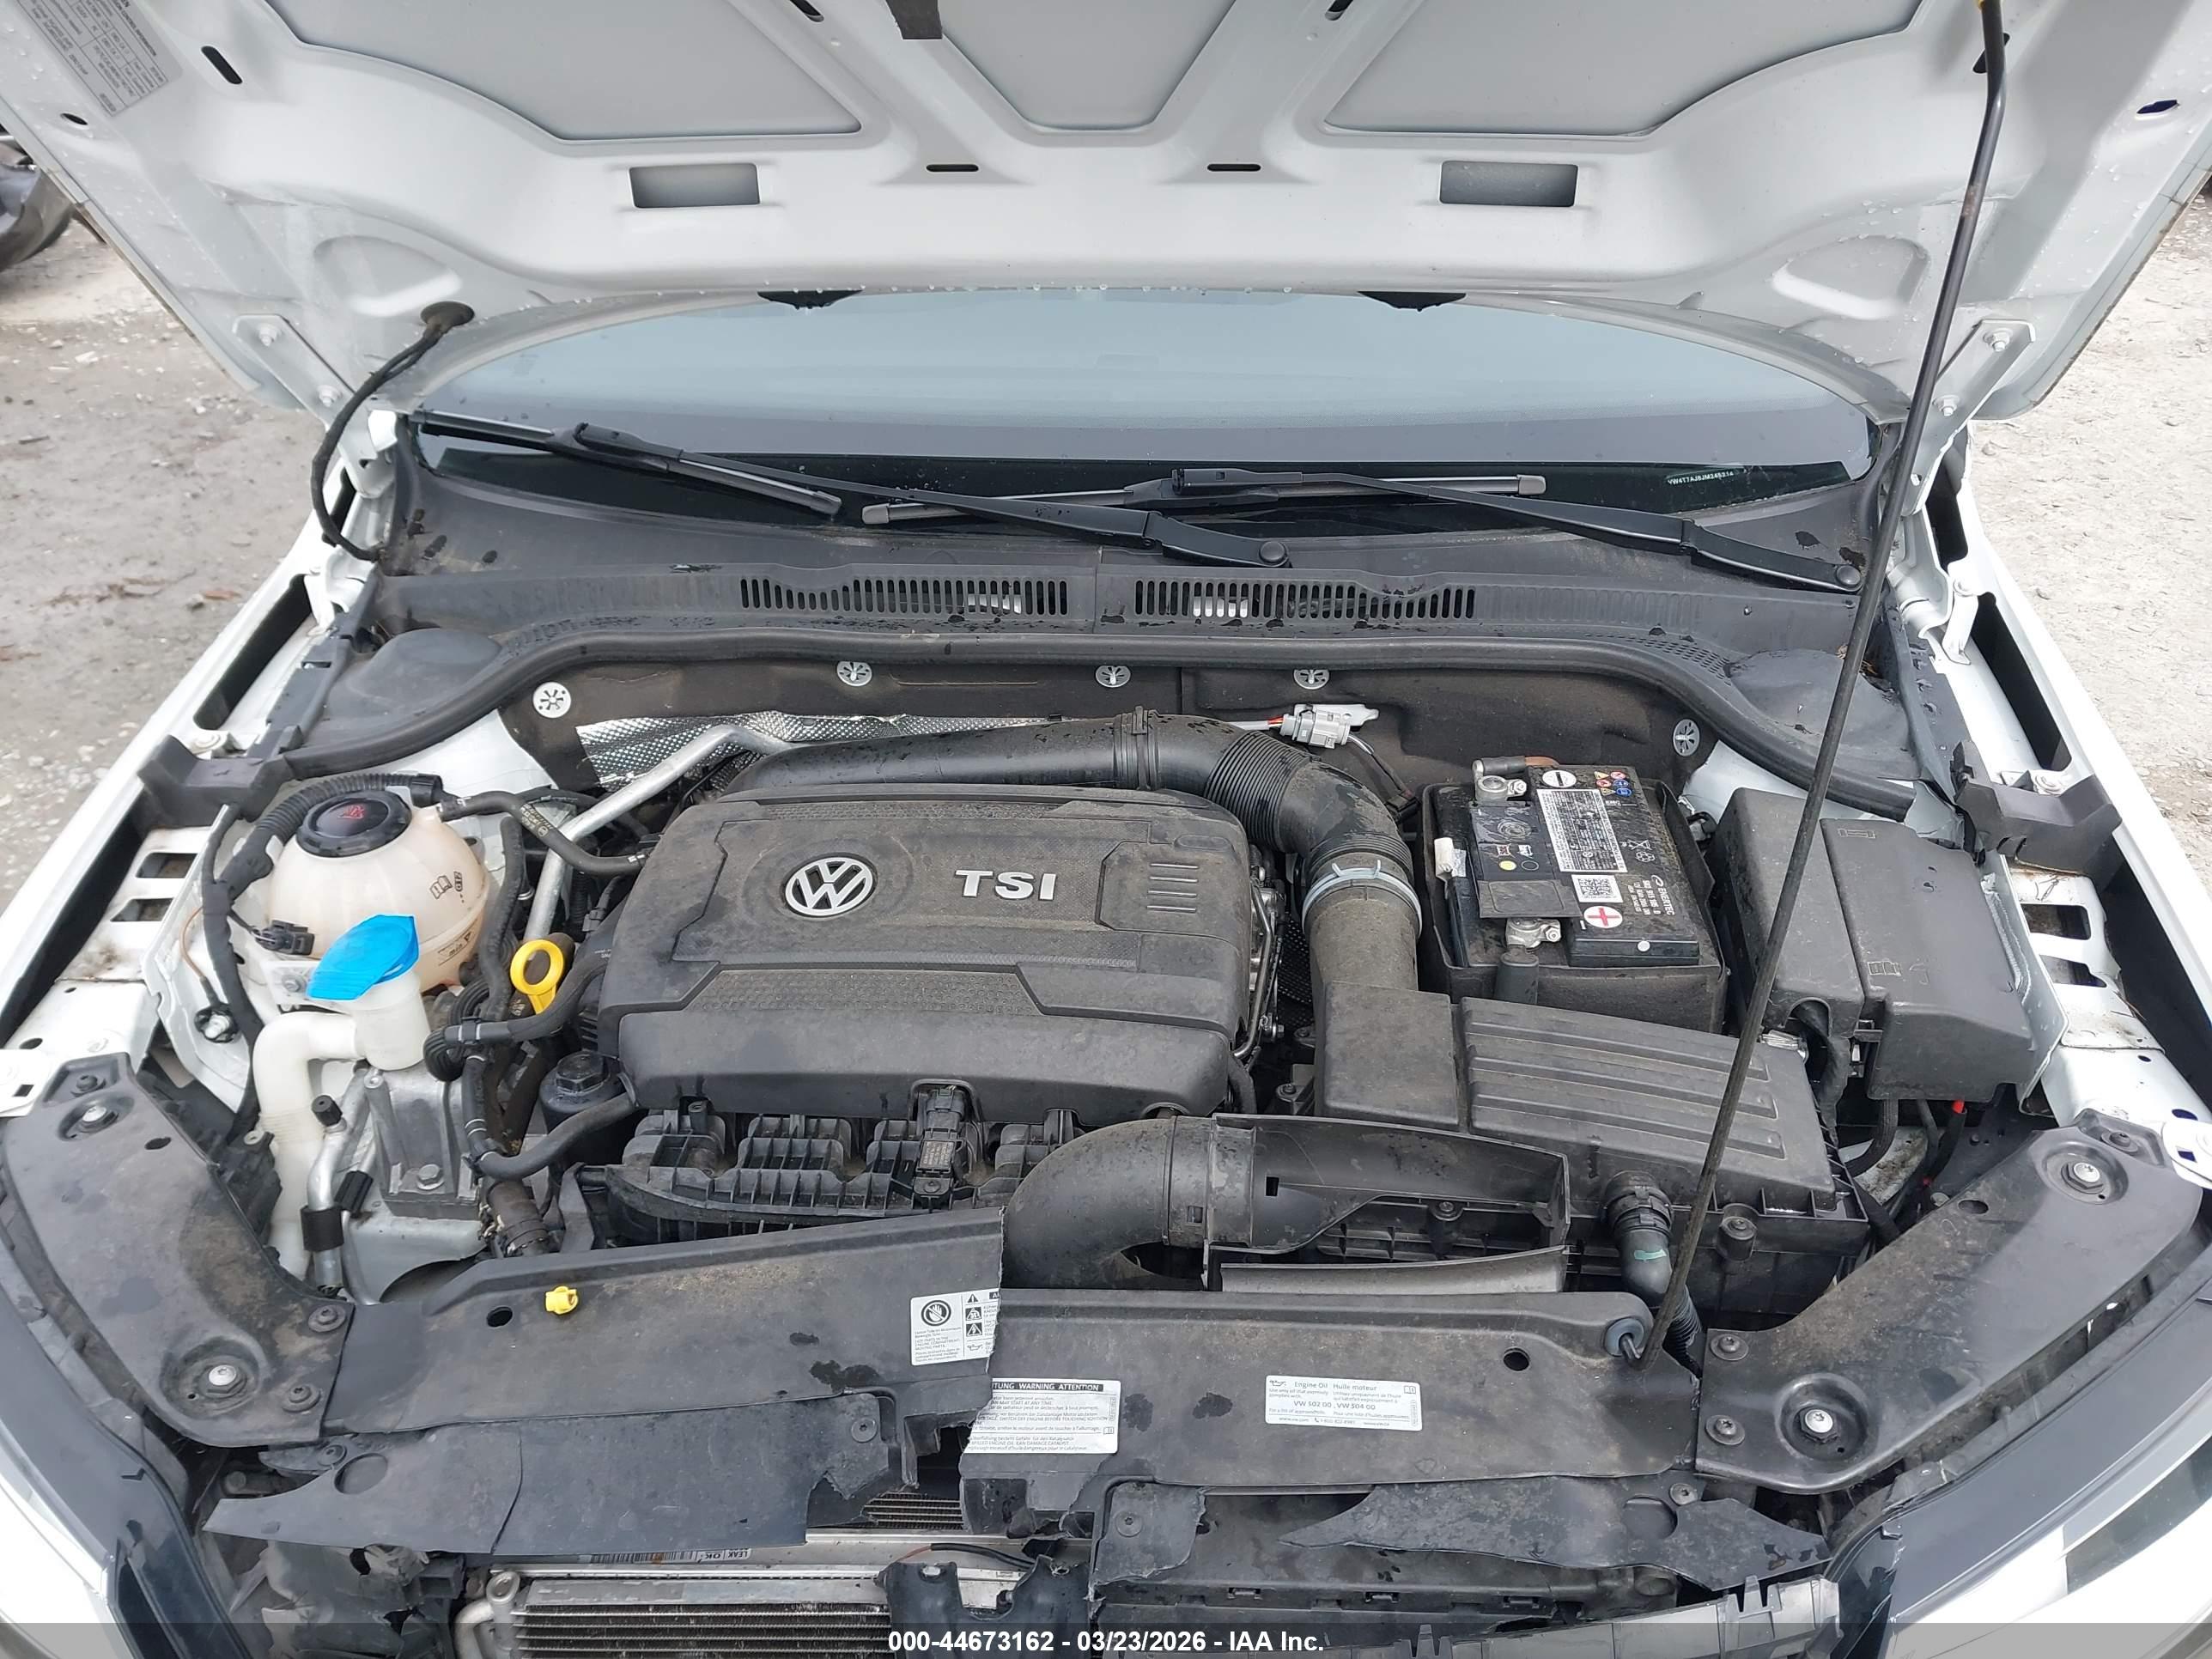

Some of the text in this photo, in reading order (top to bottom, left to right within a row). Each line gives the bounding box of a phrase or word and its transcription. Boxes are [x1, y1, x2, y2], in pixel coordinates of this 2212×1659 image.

[955, 869, 1056, 901] TSI
[1657, 887, 1675, 915] ENERTEC
[1294, 1381, 1317, 1389] Engine
